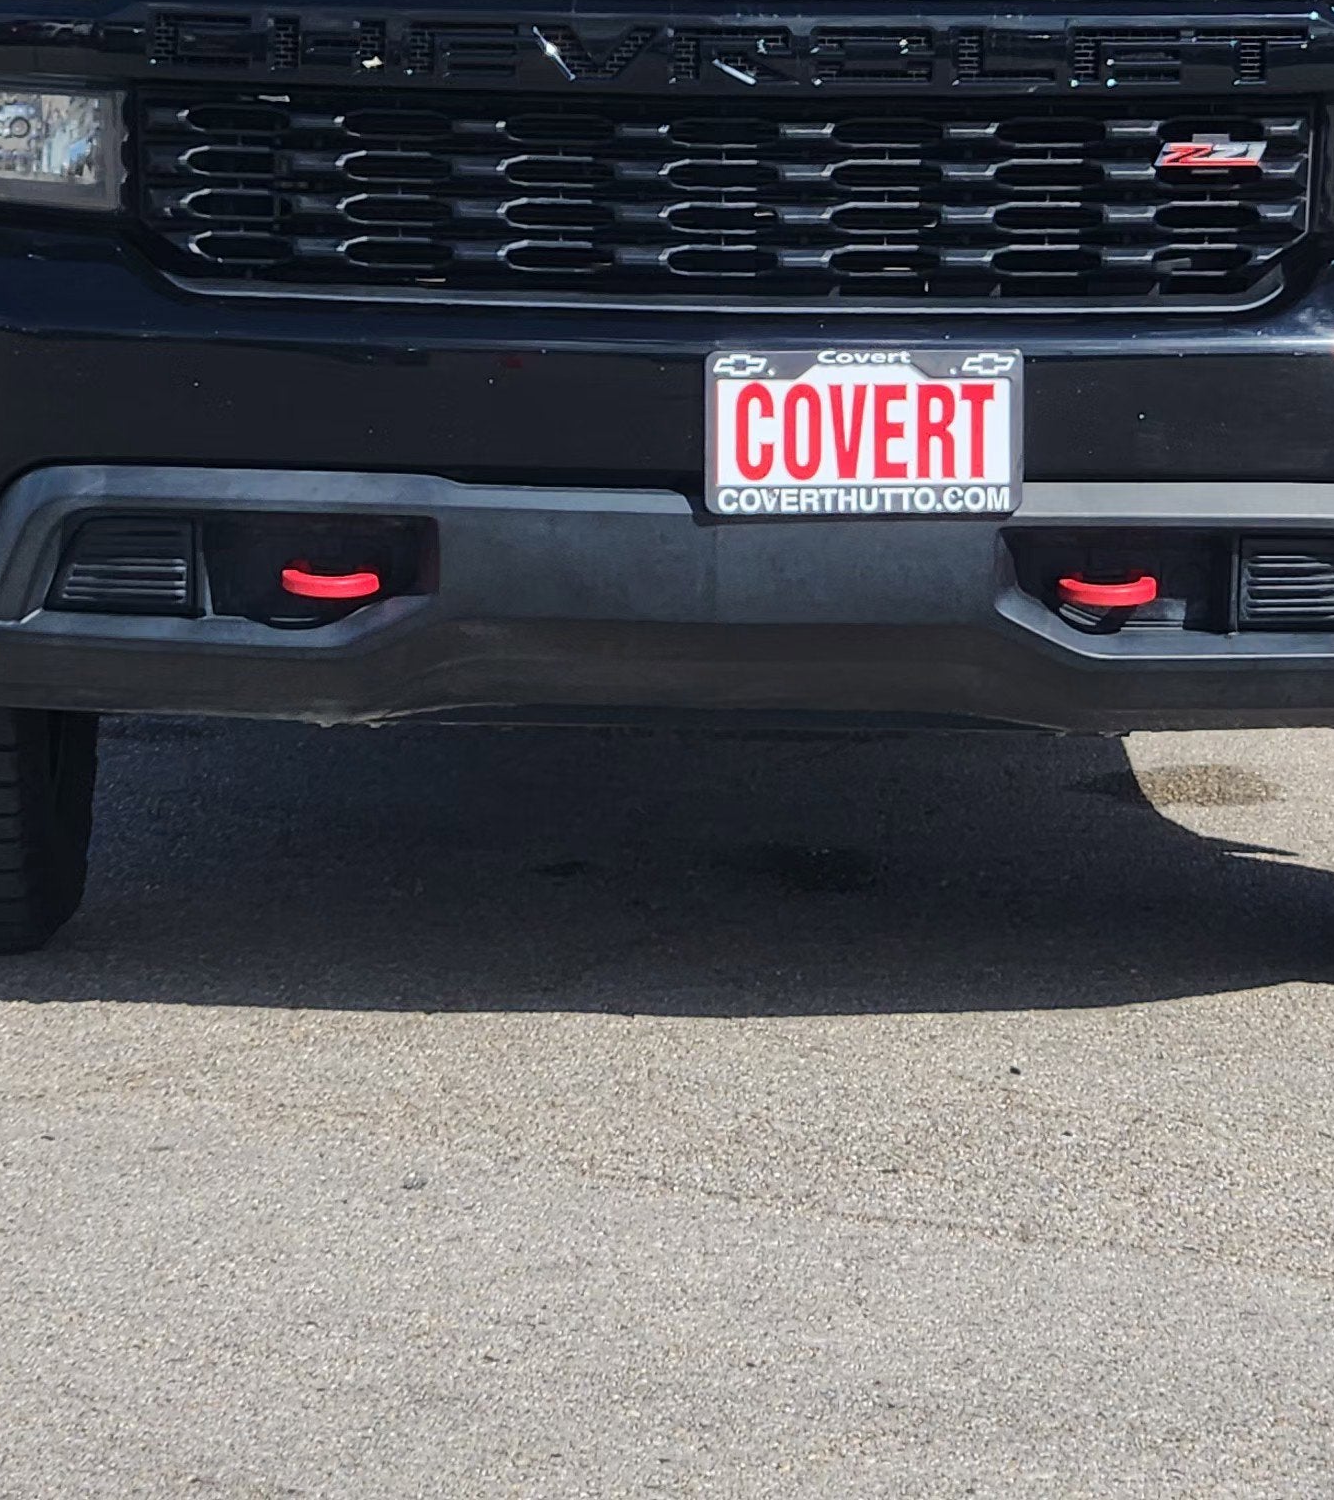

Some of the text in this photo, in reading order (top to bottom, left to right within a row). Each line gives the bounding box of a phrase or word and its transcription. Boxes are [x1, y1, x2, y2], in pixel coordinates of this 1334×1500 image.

[153, 12, 1311, 87] CHEVROLET
[817, 350, 912, 364] Covert
[735, 381, 996, 481] COVERT
[718, 486, 1011, 513] COVERTHUTTO.COM
